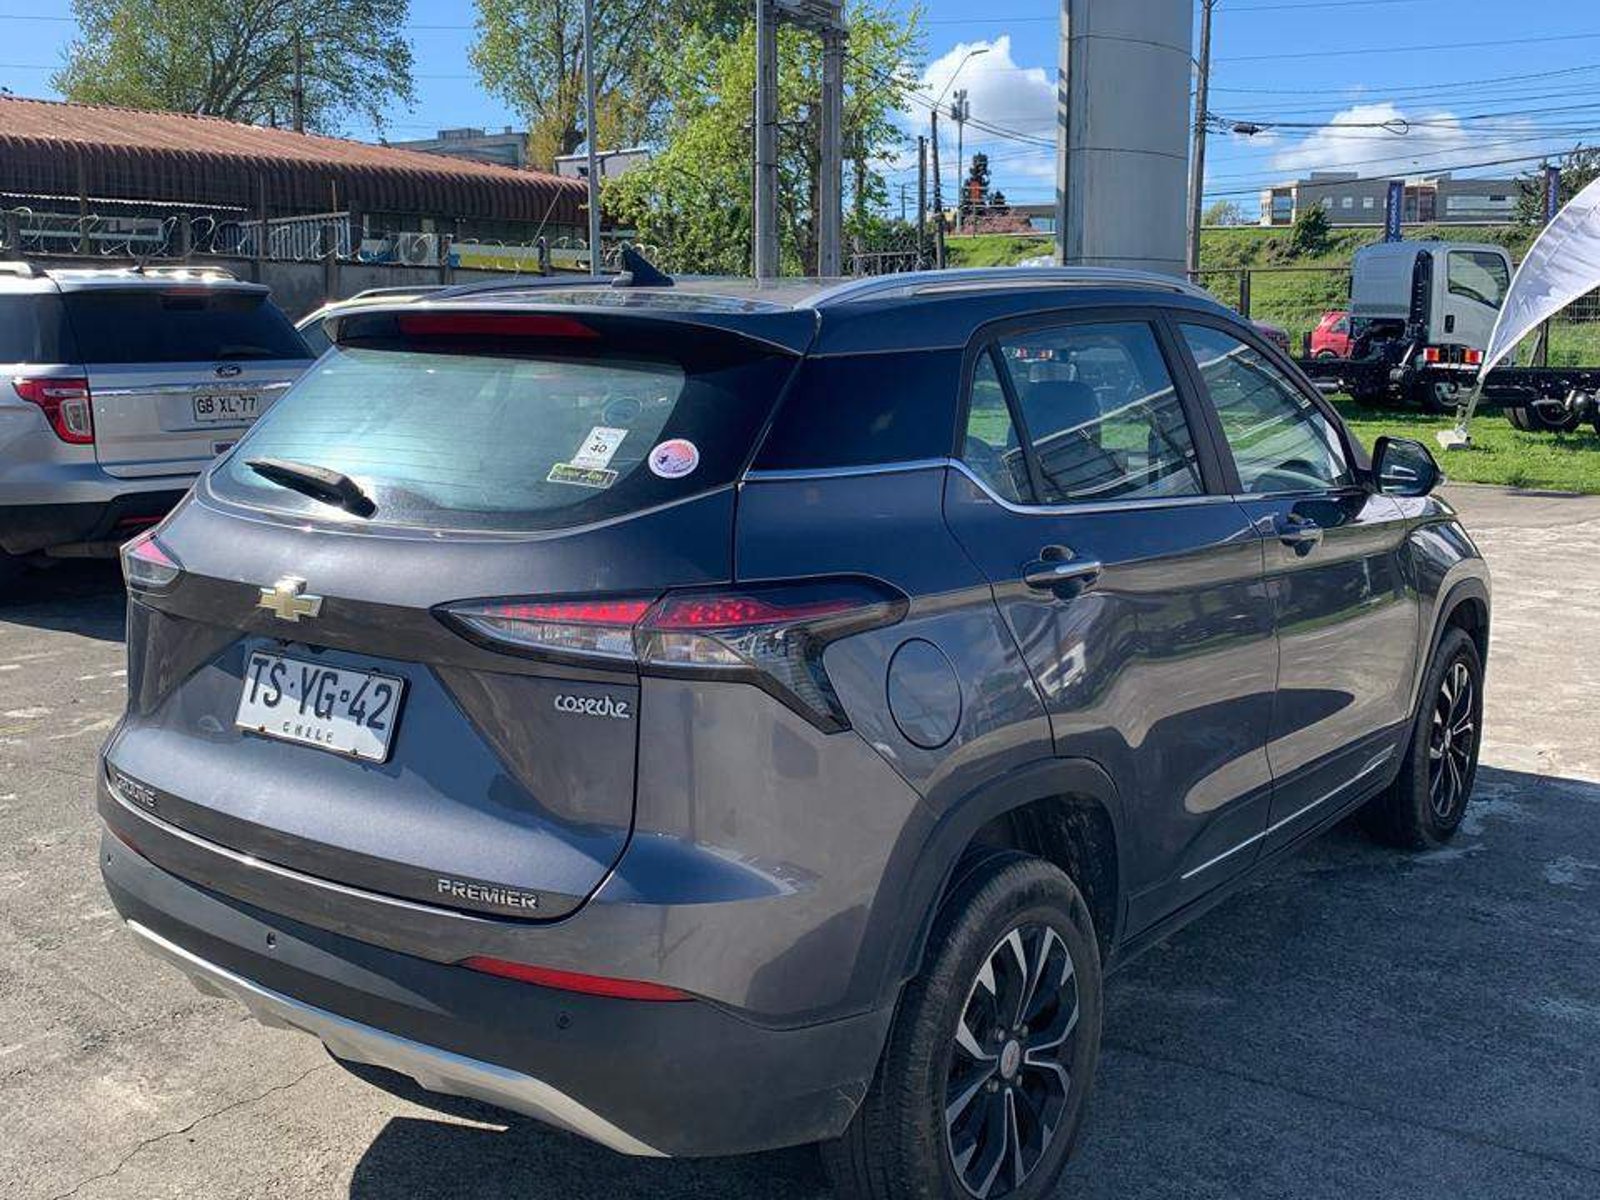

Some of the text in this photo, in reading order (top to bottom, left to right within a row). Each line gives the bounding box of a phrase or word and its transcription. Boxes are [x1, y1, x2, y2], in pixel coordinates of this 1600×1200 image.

[554, 694, 630, 719] coseche
[282, 721, 335, 744] CHILE
[437, 879, 538, 909] PREMIER
